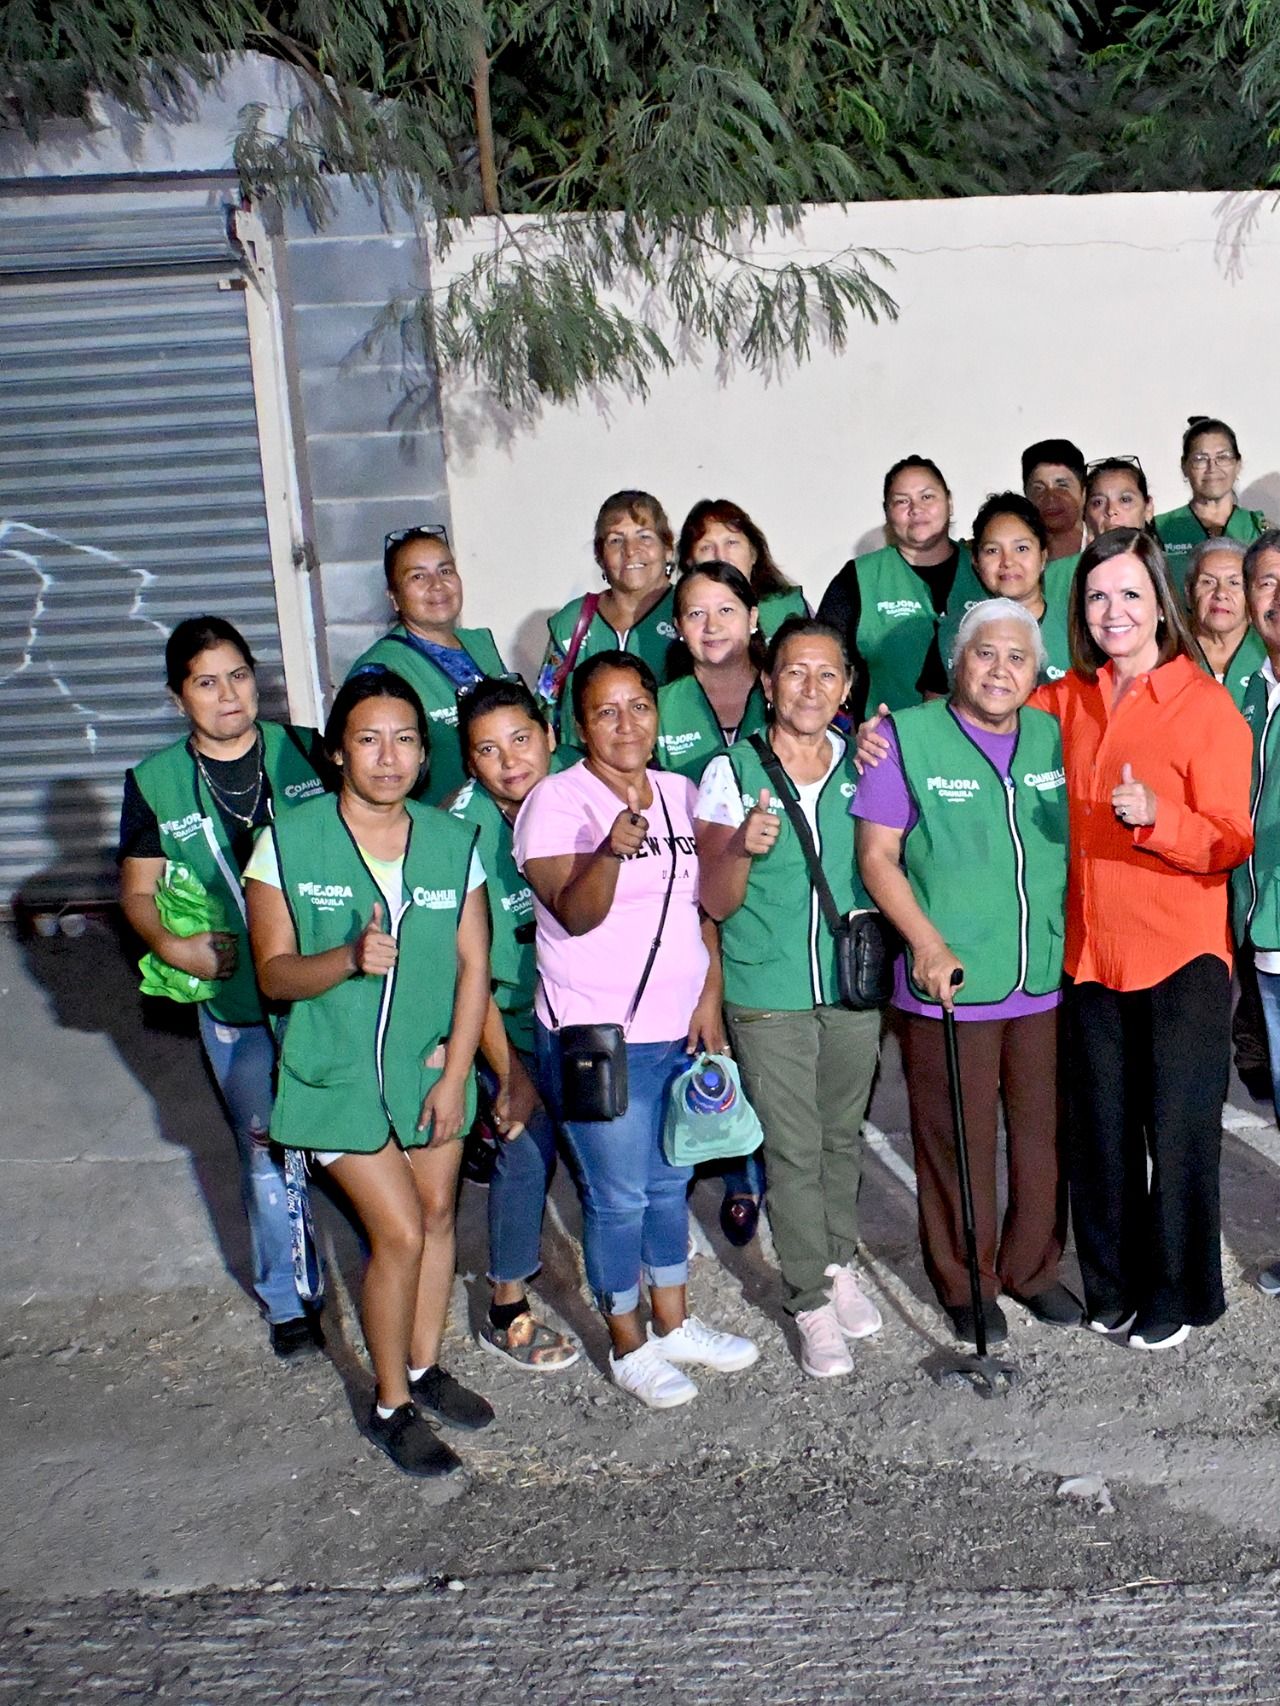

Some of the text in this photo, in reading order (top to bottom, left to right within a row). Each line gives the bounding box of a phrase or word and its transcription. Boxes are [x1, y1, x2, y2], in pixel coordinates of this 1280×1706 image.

[877, 600, 922, 612] MEJORA
[927, 776, 981, 791] MEJORA
[160, 812, 202, 834] MEJOR
[615, 836, 661, 861] EW
[501, 887, 532, 911] MEJO
